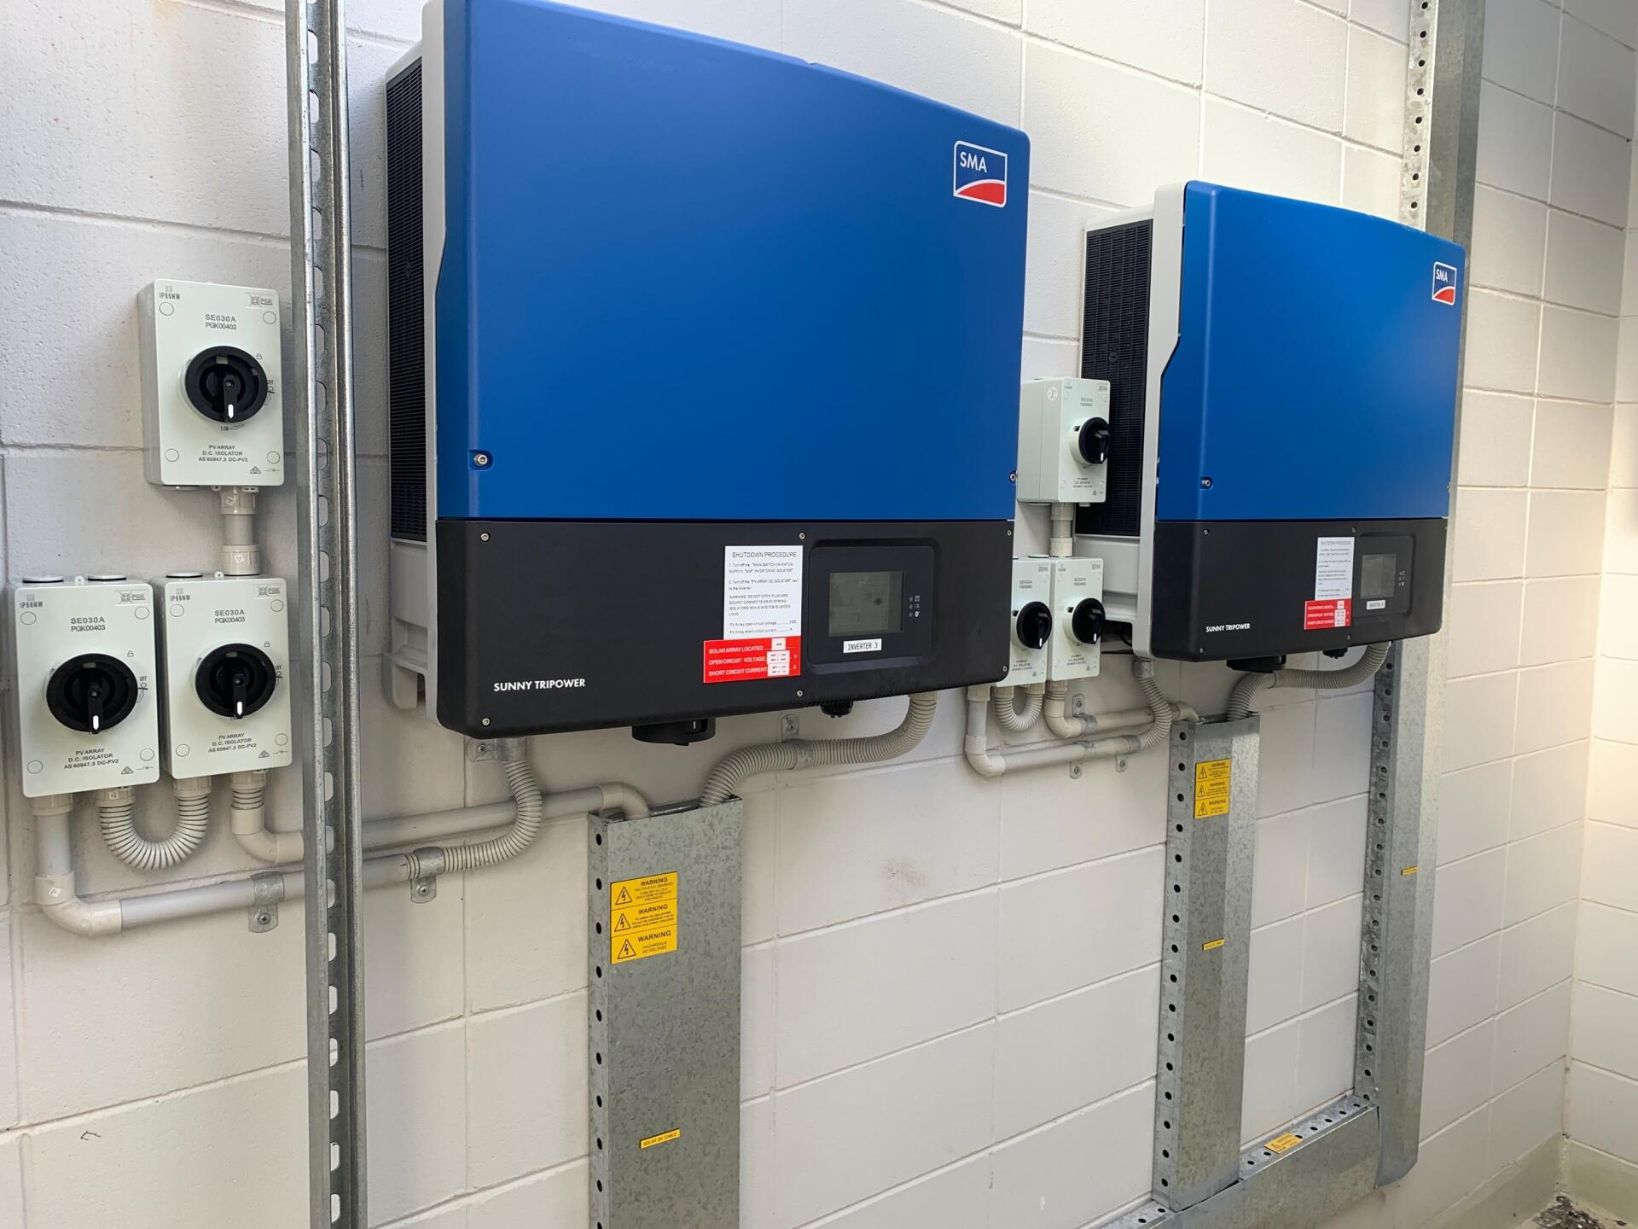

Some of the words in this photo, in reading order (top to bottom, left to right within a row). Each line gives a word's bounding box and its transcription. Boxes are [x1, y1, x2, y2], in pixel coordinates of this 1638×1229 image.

[959, 151, 988, 173] SMA
[1436, 268, 1449, 283] SMA
[205, 314, 238, 323] SE030A
[214, 609, 245, 617] SE030A
[70, 616, 106, 625] SE030A
[1206, 625, 1225, 633] SUNNY
[1226, 623, 1251, 631] TRIPOWER
[848, 642, 872, 651] INVERTER
[494, 681, 533, 692] SUNNY
[534, 678, 586, 690] TRIPOWER
[82, 753, 113, 761] ISOLATOR
[641, 877, 668, 886] WARNING
[638, 904, 668, 915] WARNING
[637, 930, 672, 943] WARNING
